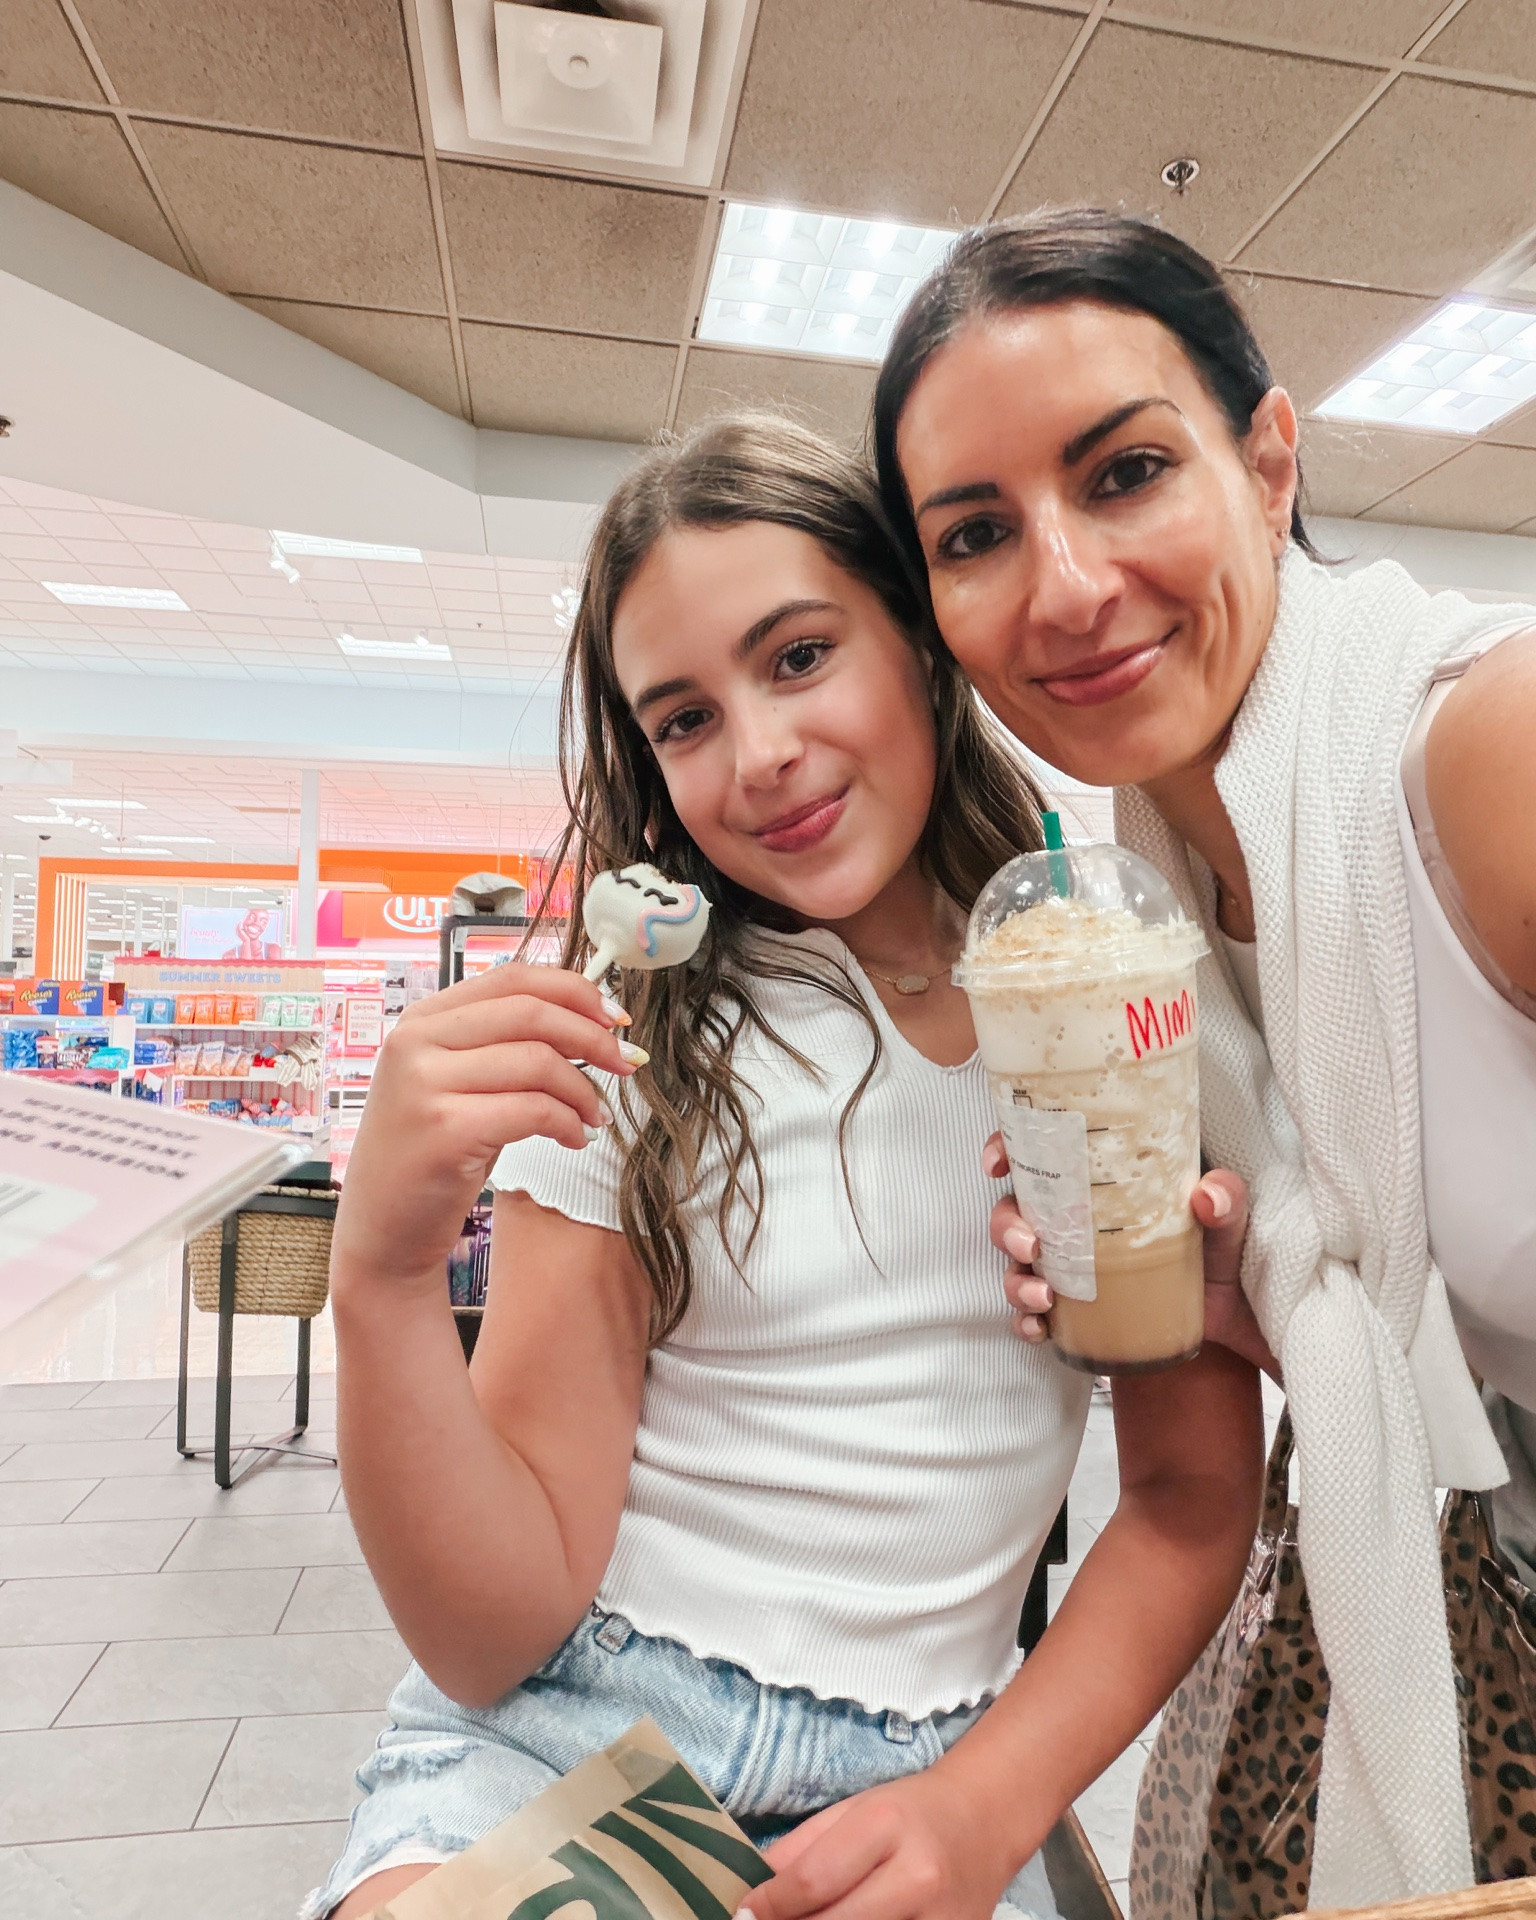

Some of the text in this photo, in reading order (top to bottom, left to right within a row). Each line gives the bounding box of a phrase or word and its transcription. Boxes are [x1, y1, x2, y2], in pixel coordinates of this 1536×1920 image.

[396, 896, 449, 920] ULT
[160, 971, 281, 984] SUMMER SWEETS
[1126, 989, 1196, 1059] MIMI
[23, 1098, 199, 1142] WATERPROOF
[41, 1140, 189, 1180] ADHESION
[1041, 1170, 1061, 1179] FRAP
